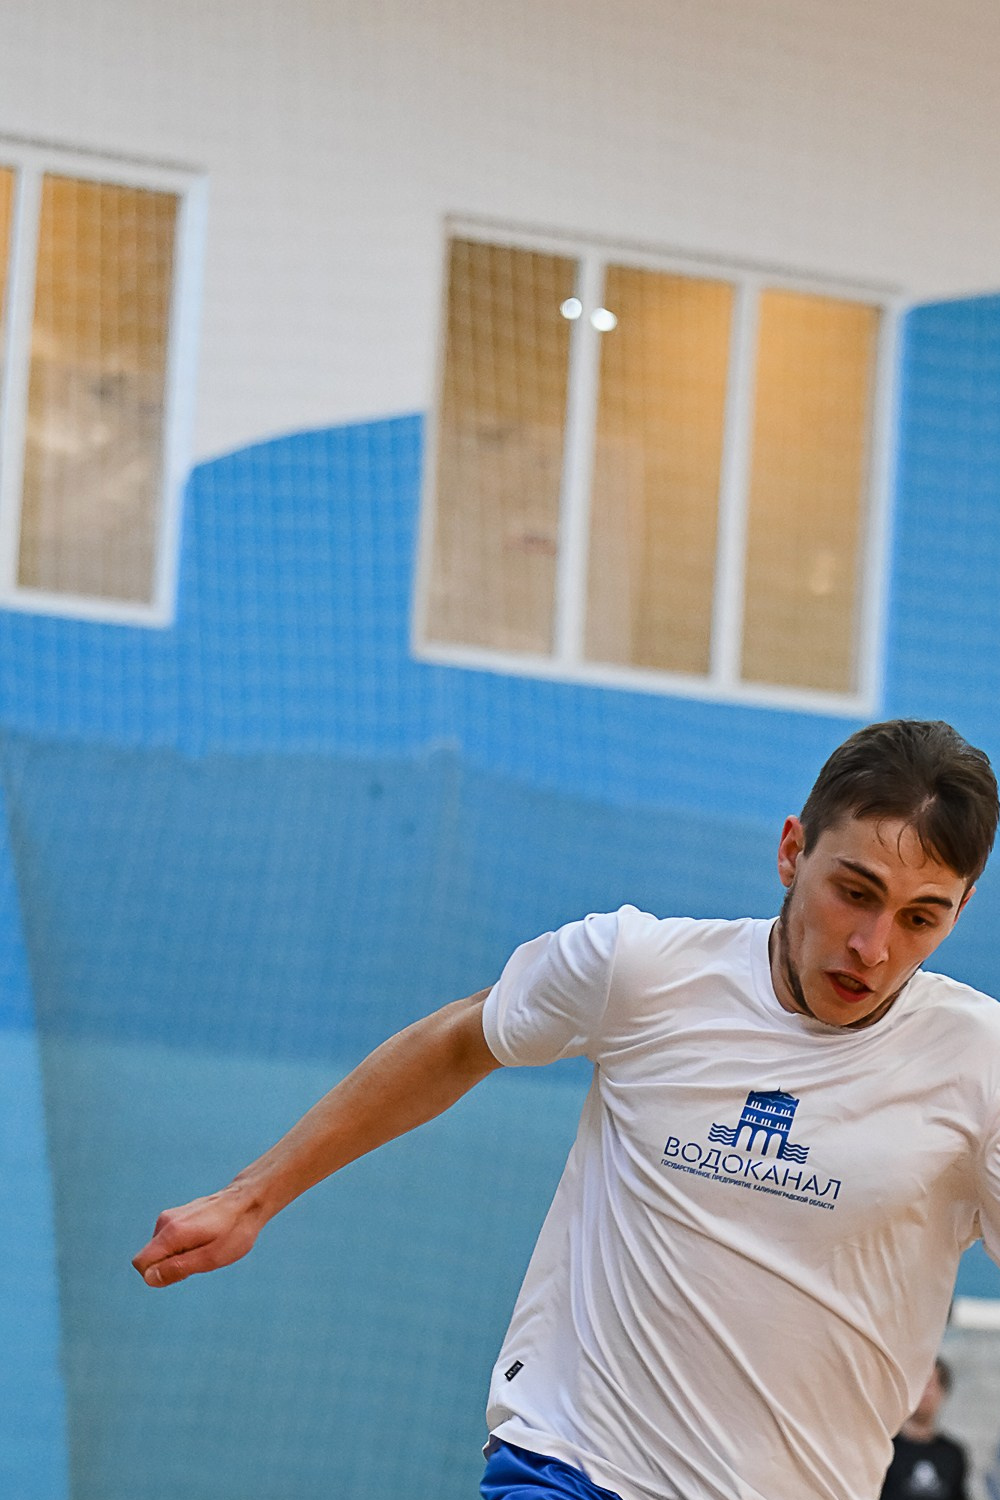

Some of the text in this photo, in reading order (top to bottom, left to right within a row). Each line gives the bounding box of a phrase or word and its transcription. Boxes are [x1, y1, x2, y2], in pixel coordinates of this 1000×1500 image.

[661, 1158, 835, 1211] ГОСУДАРСТВЕННОЕ ПРЕДПРИЯТИЕ КАЛИНИНГРАДСКОЙ ОБЛАСТИ
[664, 1136, 842, 1200] ВОДОКАНАЛ
